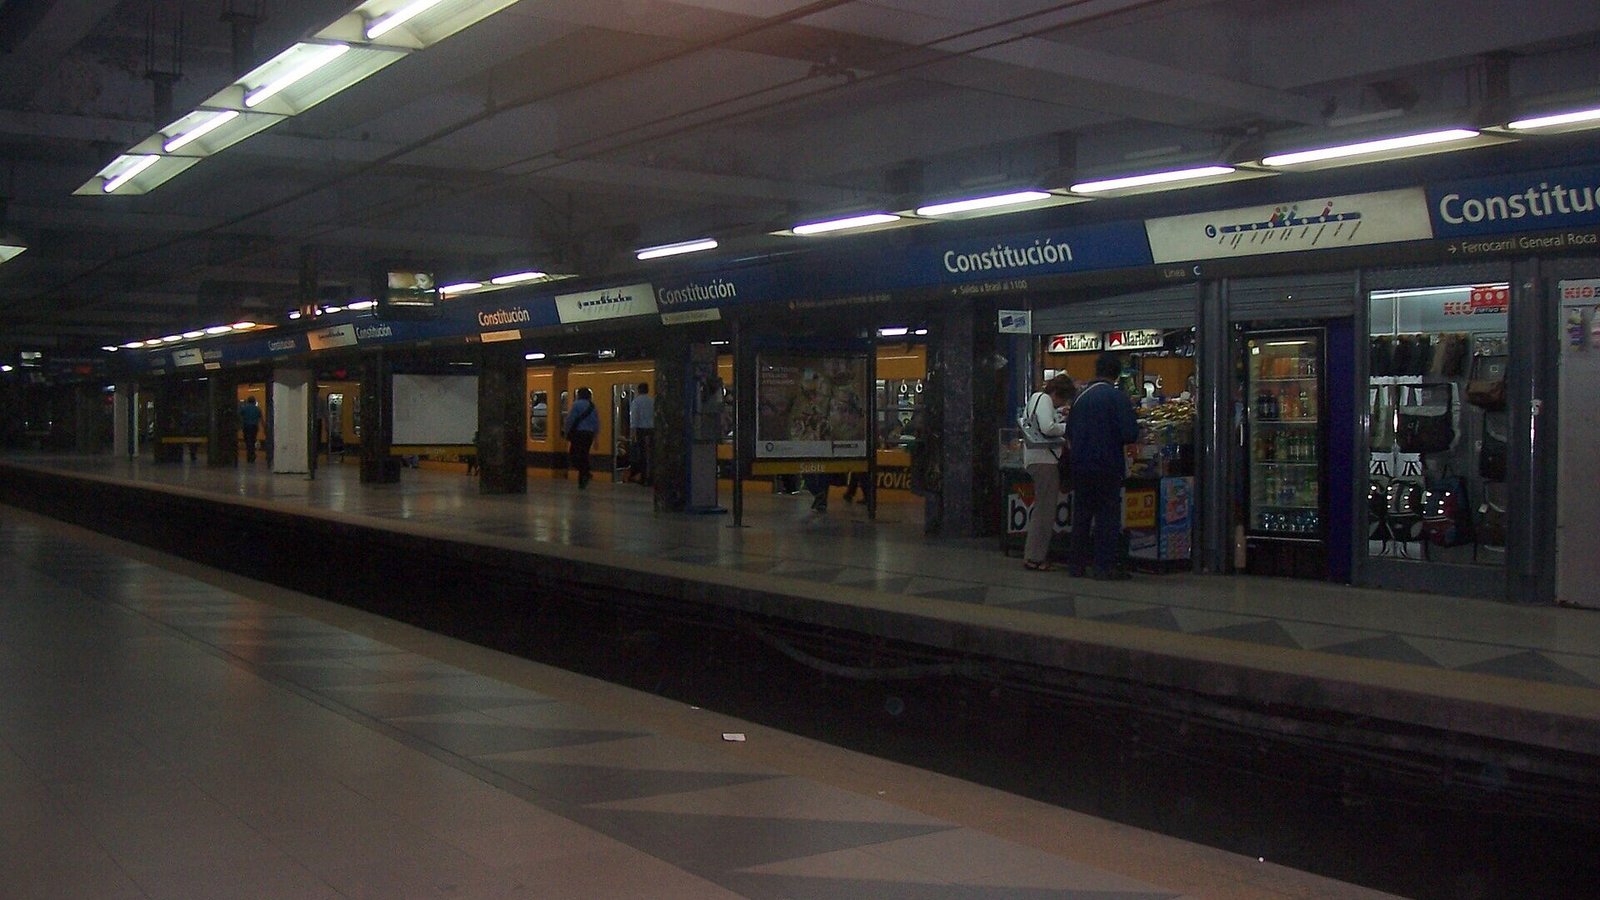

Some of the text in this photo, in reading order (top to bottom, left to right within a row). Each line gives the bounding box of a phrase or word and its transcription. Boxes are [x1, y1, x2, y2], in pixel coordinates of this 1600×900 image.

[1461, 233, 1598, 254] Ferrocarril General Roca
[943, 238, 1073, 273] Constitución
[1193, 265, 1201, 276] C
[658, 279, 737, 304] Constitución
[477, 306, 531, 327] Constitución
[1066, 335, 1100, 350] Marlboro
[1124, 330, 1160, 347] Marlboro
